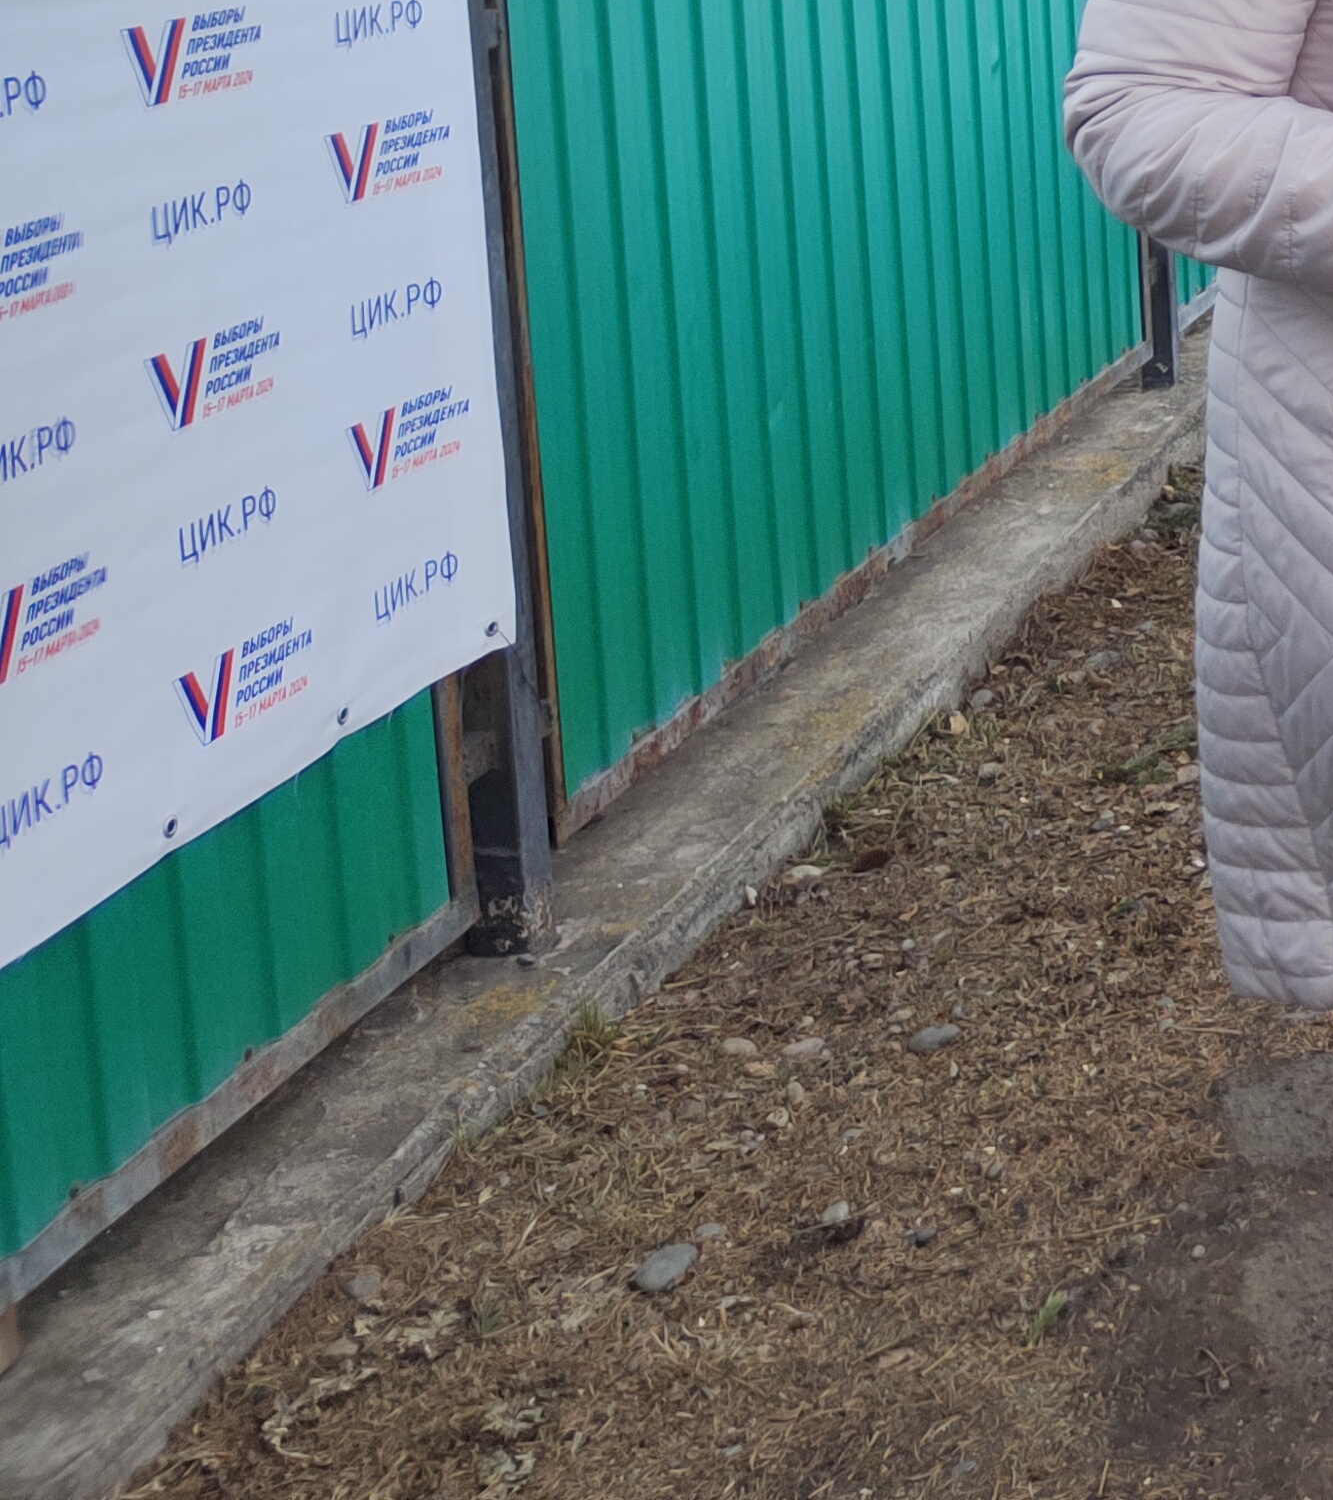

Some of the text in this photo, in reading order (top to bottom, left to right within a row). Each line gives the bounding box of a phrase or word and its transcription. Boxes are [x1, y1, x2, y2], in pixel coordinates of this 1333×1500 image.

[191, 5, 246, 32] ВЫБОРЫ
[186, 24, 262, 56] ПРЕЗИДЕНТА
[181, 53, 231, 80] РОССИИ
[0, 70, 46, 118] .РФ
[379, 125, 450, 156] ПРЕЗИДЕНТА
[384, 108, 433, 135] ВЫБОРЫ
[375, 152, 420, 178] РОССИИ
[4, 212, 65, 248] ВЫБОРЫ
[151, 178, 251, 245] ЦИК.РФ
[0, 231, 84, 275] ПРЕЗИДЕНТА
[351, 276, 442, 339] ЦИК.РФ
[208, 331, 280, 374] ПРЕЗИДЕНТА
[213, 315, 264, 350] ВЫБОРЫ
[204, 363, 253, 399] РОССИИ
[179, 485, 277, 564] ЦИК.РФ
[374, 550, 459, 622] ЦИК.РФ
[238, 628, 312, 683] ПРЕЗИДЕНТА
[241, 616, 294, 659] ВЫБОРЫ
[235, 666, 284, 708] РОССИИ
